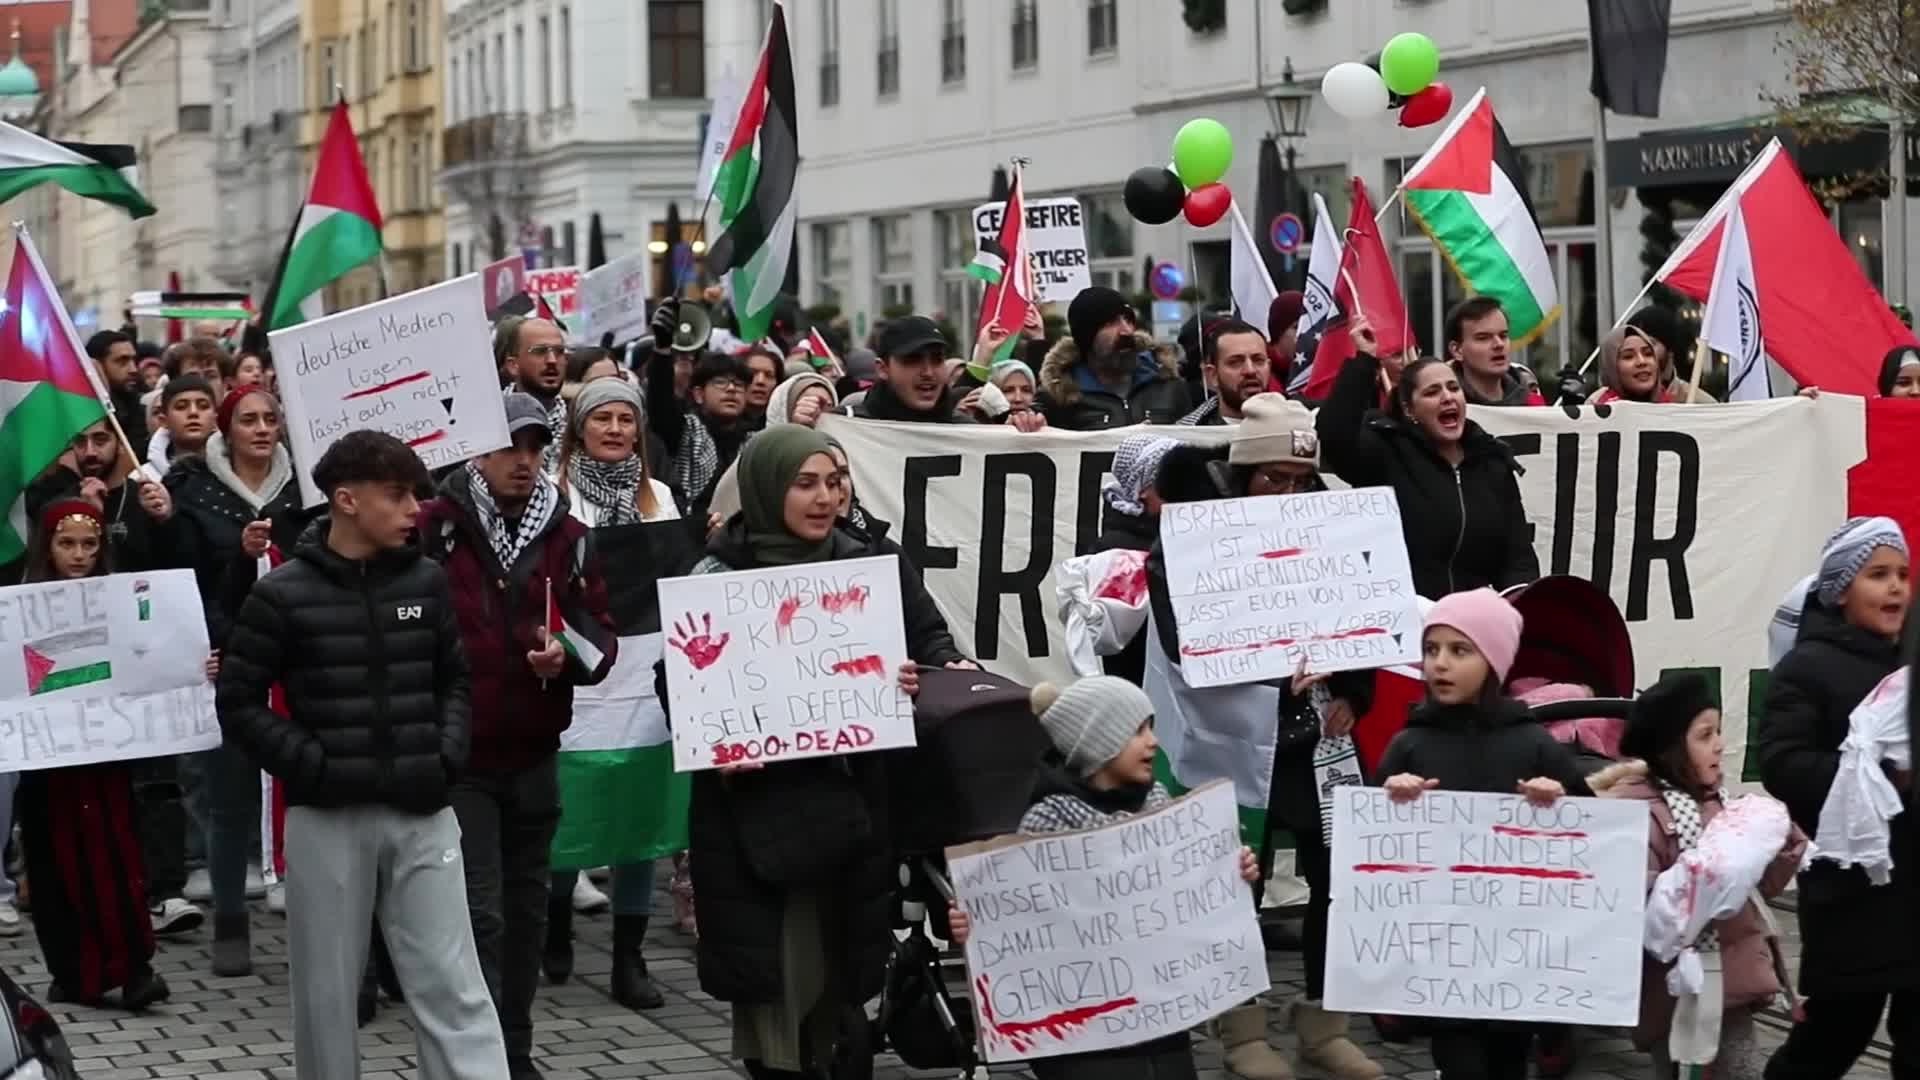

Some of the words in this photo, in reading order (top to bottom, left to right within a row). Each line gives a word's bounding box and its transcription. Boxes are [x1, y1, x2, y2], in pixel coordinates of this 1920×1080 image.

[976, 204, 1081, 232] CEEFIRE
[296, 333, 370, 376] deutsche
[379, 311, 455, 344] Medien
[358, 396, 396, 421] euch
[412, 374, 462, 401] nicht
[1167, 501, 1257, 536] ISRAEL
[1279, 492, 1398, 522] KRITISIEREN
[1209, 536, 1243, 560] IST
[1260, 525, 1325, 550] NICHT
[397, 605, 422, 620] EA7
[724, 573, 870, 616] BOMBING
[1248, 590, 1297, 612] EUCH
[1308, 586, 1345, 604] VON
[1352, 579, 1405, 601] DER
[747, 613, 850, 651] KIDS
[1335, 610, 1403, 635] LOBBY
[728, 660, 768, 699] IS
[796, 643, 869, 682] NOT
[1203, 650, 1264, 682] NICHT
[701, 703, 769, 745] SELF
[787, 685, 913, 728] DEFENCE
[796, 724, 875, 752] DEAD
[1351, 791, 1475, 825] REICHEN
[1496, 797, 1593, 830] 5000+
[959, 862, 1009, 890] WIE
[1024, 836, 1100, 874] VIELE
[1119, 802, 1212, 858] KINDER
[1359, 831, 1434, 864] TOTE
[1459, 836, 1591, 869] KINDER
[966, 882, 1069, 925] MÜSSEN
[1096, 861, 1162, 900] NOCH
[1354, 880, 1425, 912] NICHT
[1452, 876, 1504, 907] FÜR
[1518, 881, 1620, 912] EINEN
[977, 923, 1056, 969] DAMIT
[1073, 911, 1123, 949] WIR
[1132, 898, 1168, 939] ES
[1173, 873, 1237, 926] EINEN
[992, 956, 1134, 1018] GENOZID
[1154, 935, 1247, 985] NENNEN
[1402, 976, 1523, 1011] STAND
